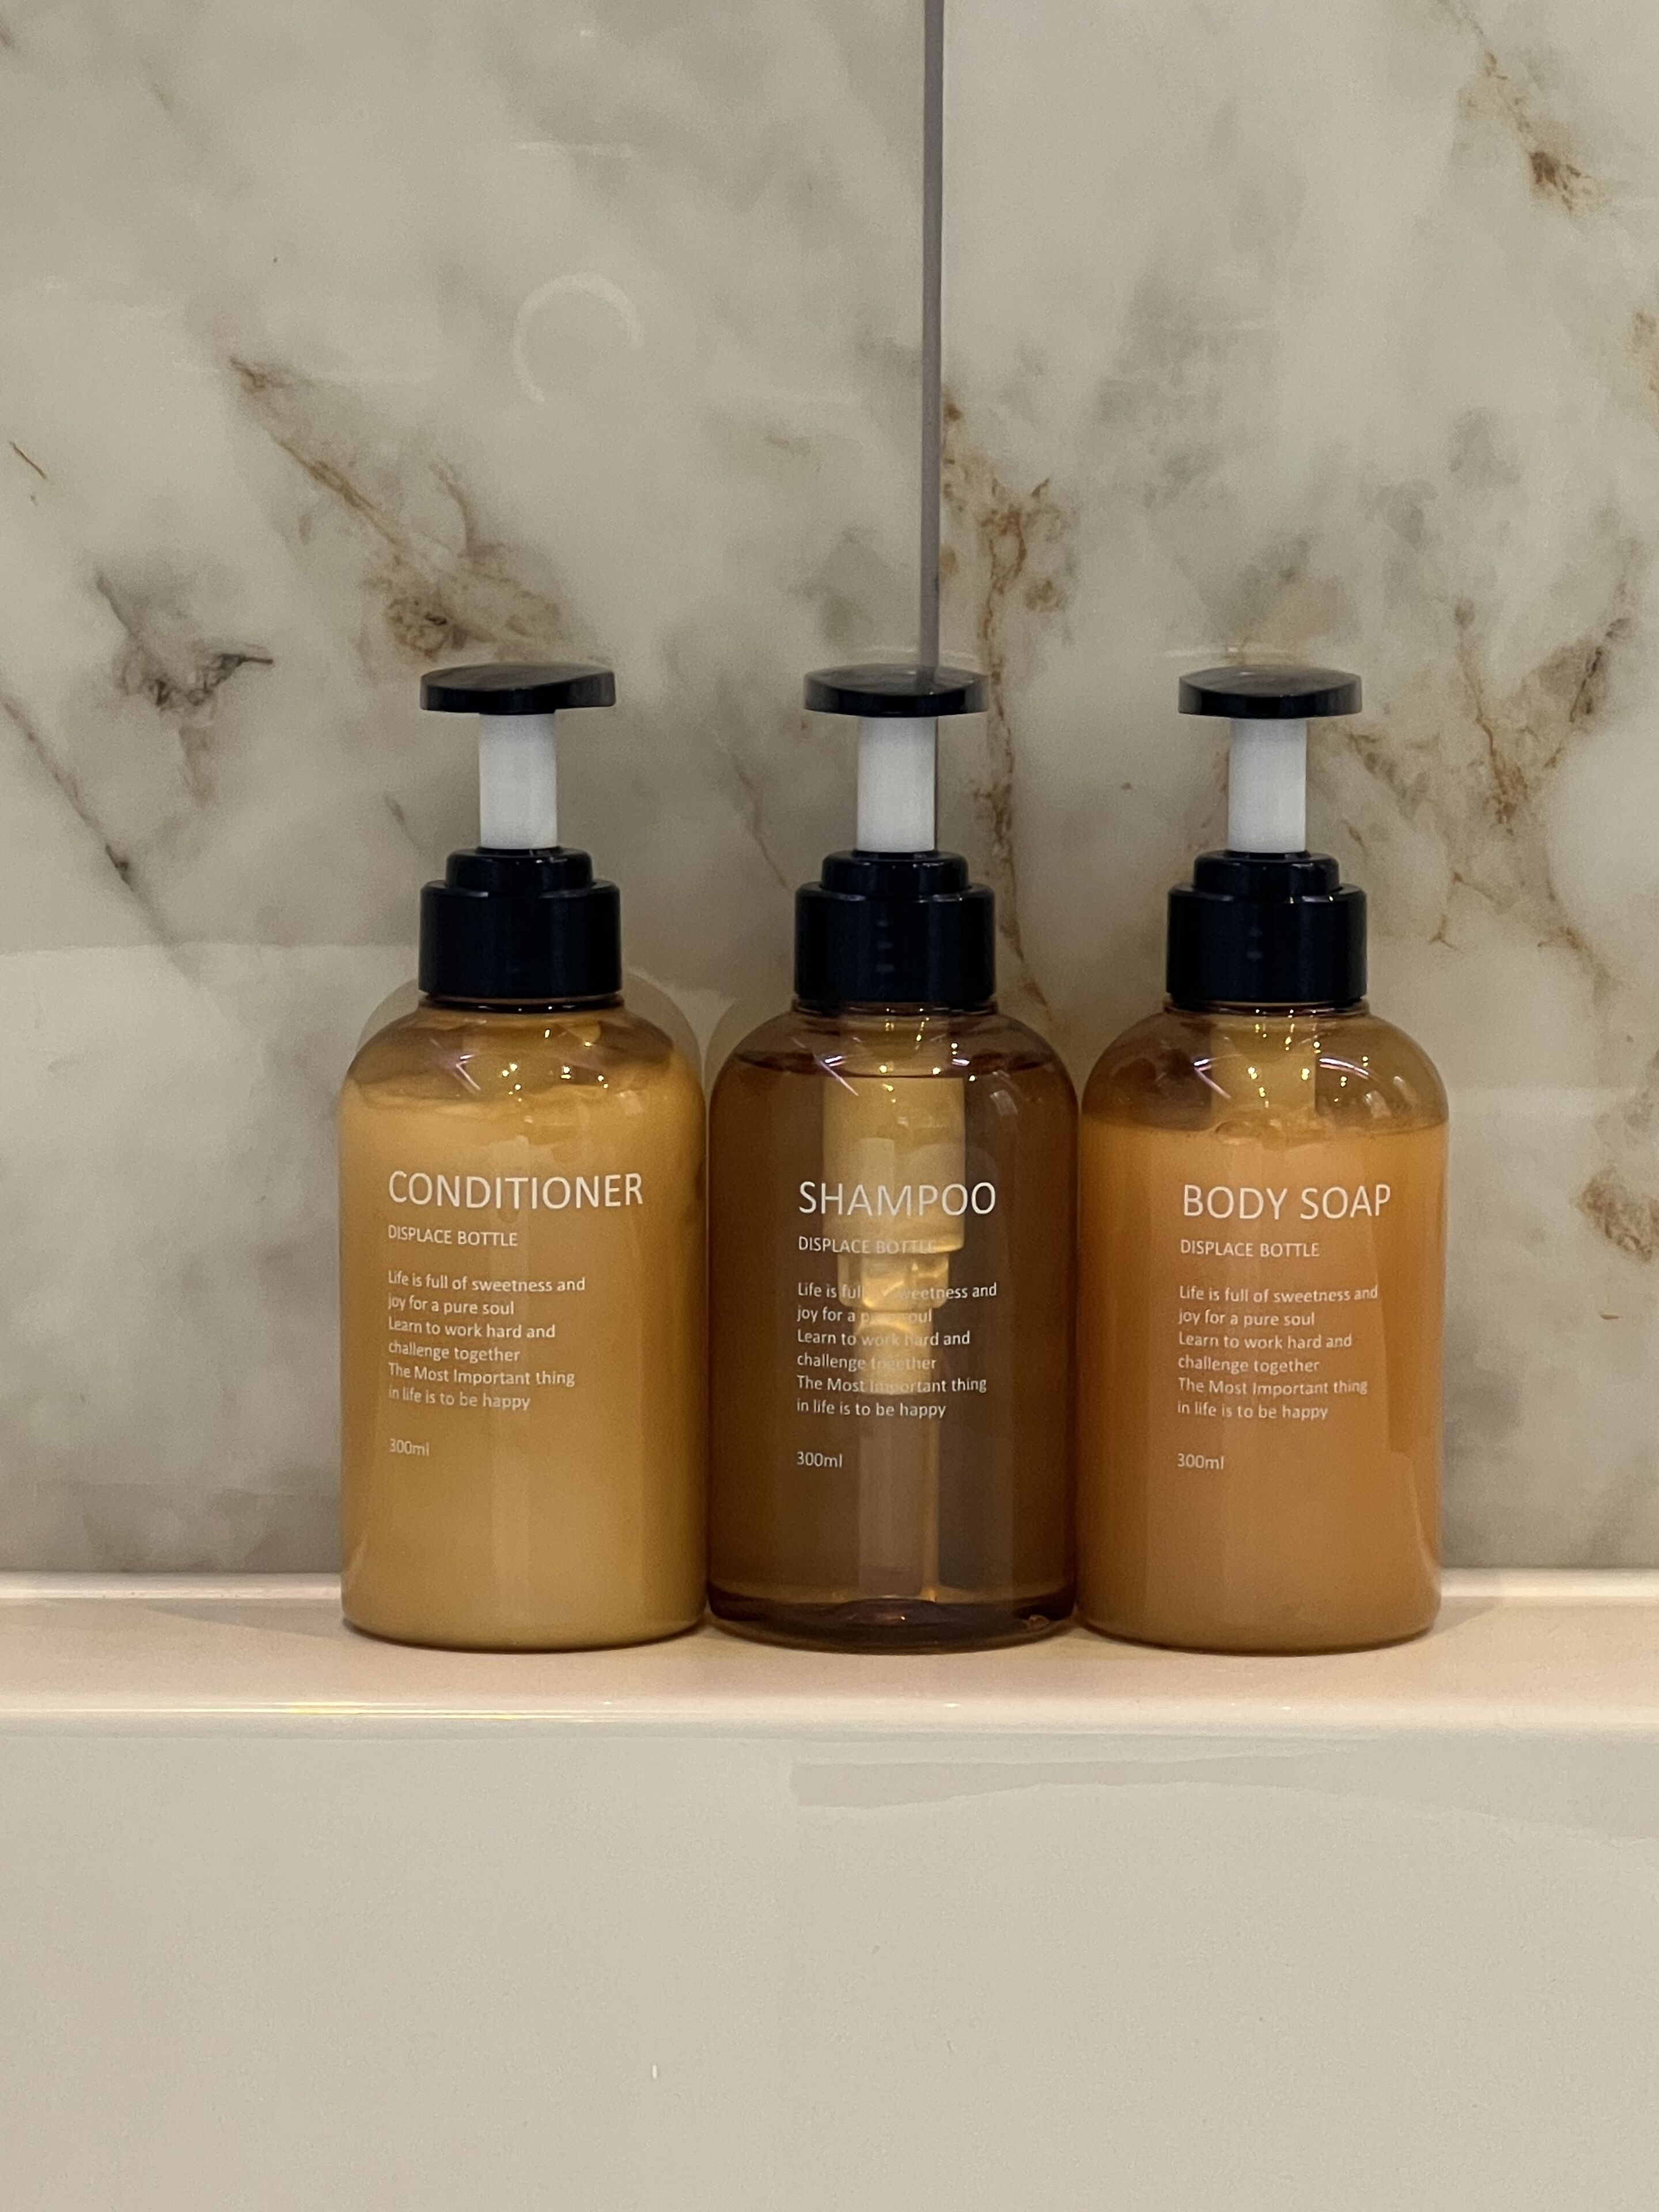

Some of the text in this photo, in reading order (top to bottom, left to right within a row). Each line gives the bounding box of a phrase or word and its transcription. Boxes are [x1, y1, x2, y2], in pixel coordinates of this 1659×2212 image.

[388, 1171, 643, 1210] CONDITIONER
[798, 1181, 997, 1216] SHAMPOO
[1183, 1184, 1391, 1221] BODY SOAP
[388, 1224, 518, 1247] DISPLACE BOTTLE
[798, 1236, 937, 1255] DISPLACE BOTTLE
[1180, 1239, 1320, 1257] DISPLACE BOTTLE
[388, 1270, 586, 1292] Life is full of sweetness and
[797, 1282, 822, 1297] Life
[825, 1283, 837, 1298] is
[842, 1283, 865, 1300] ful
[972, 1282, 997, 1297] and
[387, 1293, 515, 1316] joy for a pure soul
[1179, 1285, 1377, 1304] Life is full of sweetness and
[797, 1305, 818, 1322] joy
[822, 1306, 843, 1322] for
[847, 1310, 855, 1322] a
[898, 1308, 932, 1323] oul
[1179, 1309, 1315, 1327] joy for a pure soul
[388, 1316, 555, 1338] Learn to work hard and
[797, 1328, 970, 1346] Learn to work hard and
[1179, 1332, 1352, 1350] Learn to work hard and
[388, 1340, 521, 1363] challenge together
[797, 1353, 865, 1372] challenge
[1177, 1355, 1319, 1375] challenge together
[388, 1362, 575, 1388] The Most Important thing
[797, 1374, 823, 1389] The
[827, 1377, 865, 1392] Most
[951, 1377, 987, 1394] thing
[1179, 1377, 1368, 1397] The Most Important thing
[388, 1386, 531, 1411] in life is to be happy
[797, 1399, 946, 1419] in life is to be happy
[1177, 1401, 1328, 1421] in life is to be happy
[389, 1438, 430, 1457] 300ml
[797, 1451, 843, 1468] 300ml
[1177, 1453, 1224, 1470] 300ml
